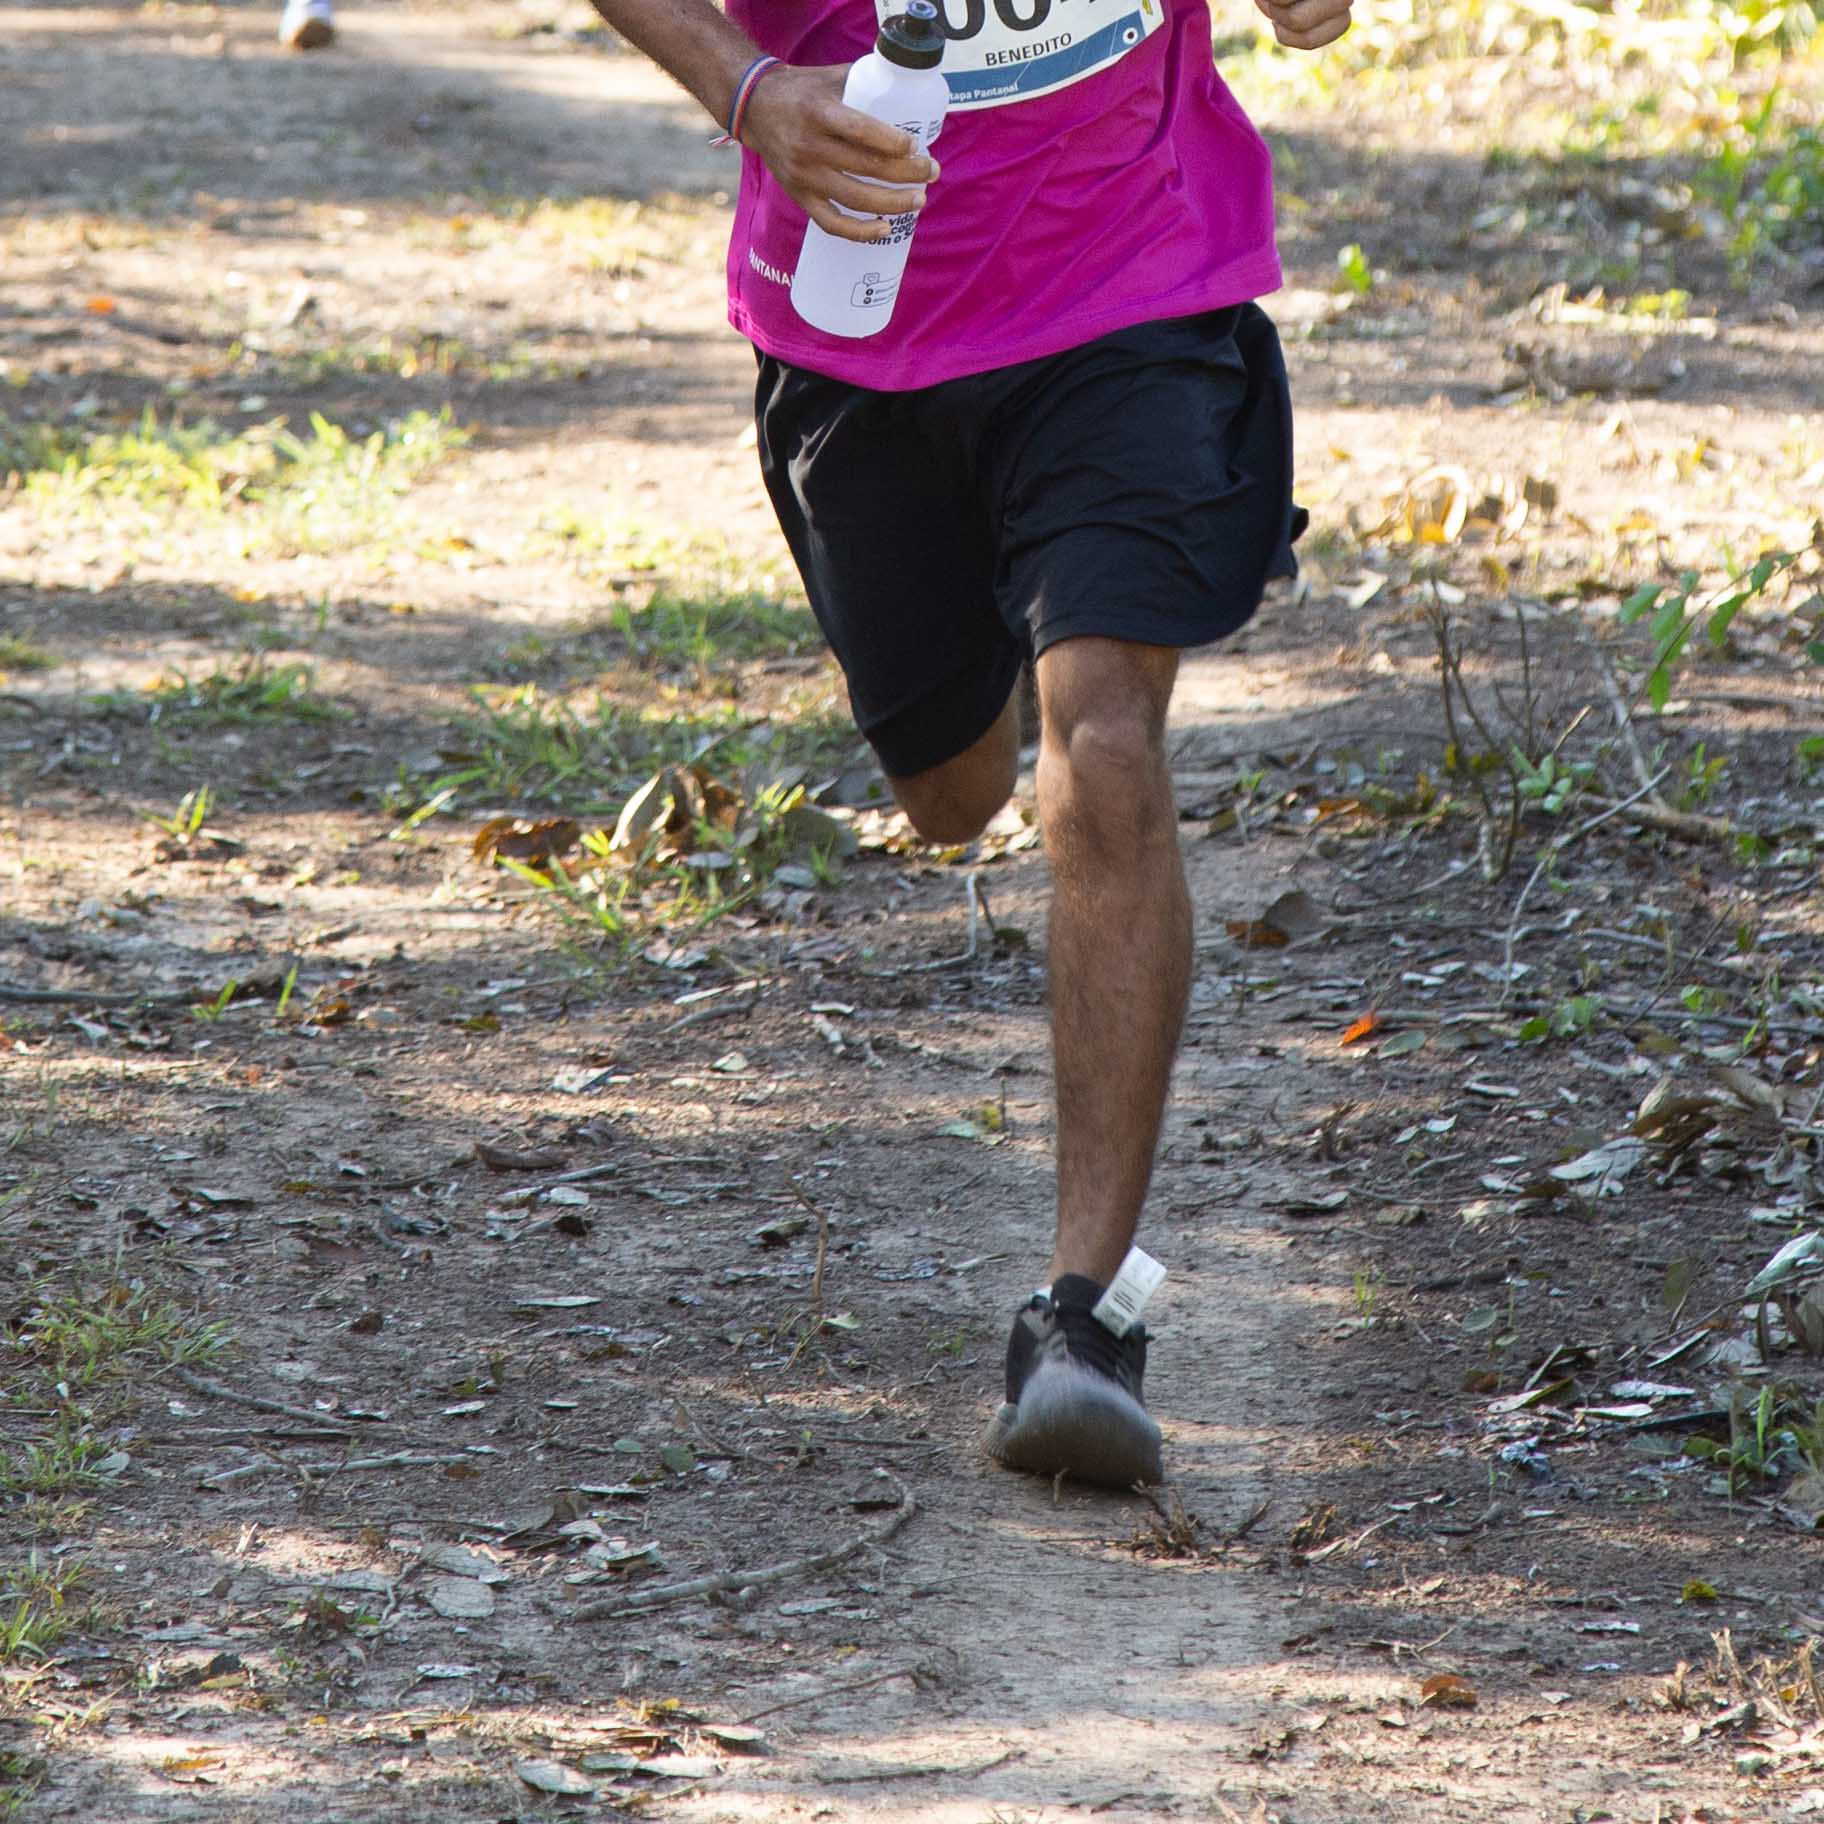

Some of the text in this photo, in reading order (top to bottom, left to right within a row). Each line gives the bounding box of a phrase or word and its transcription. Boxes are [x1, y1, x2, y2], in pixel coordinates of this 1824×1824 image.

[985, 32, 1072, 66] BENEDITO
[948, 80, 1019, 102] tapa Pantanal
